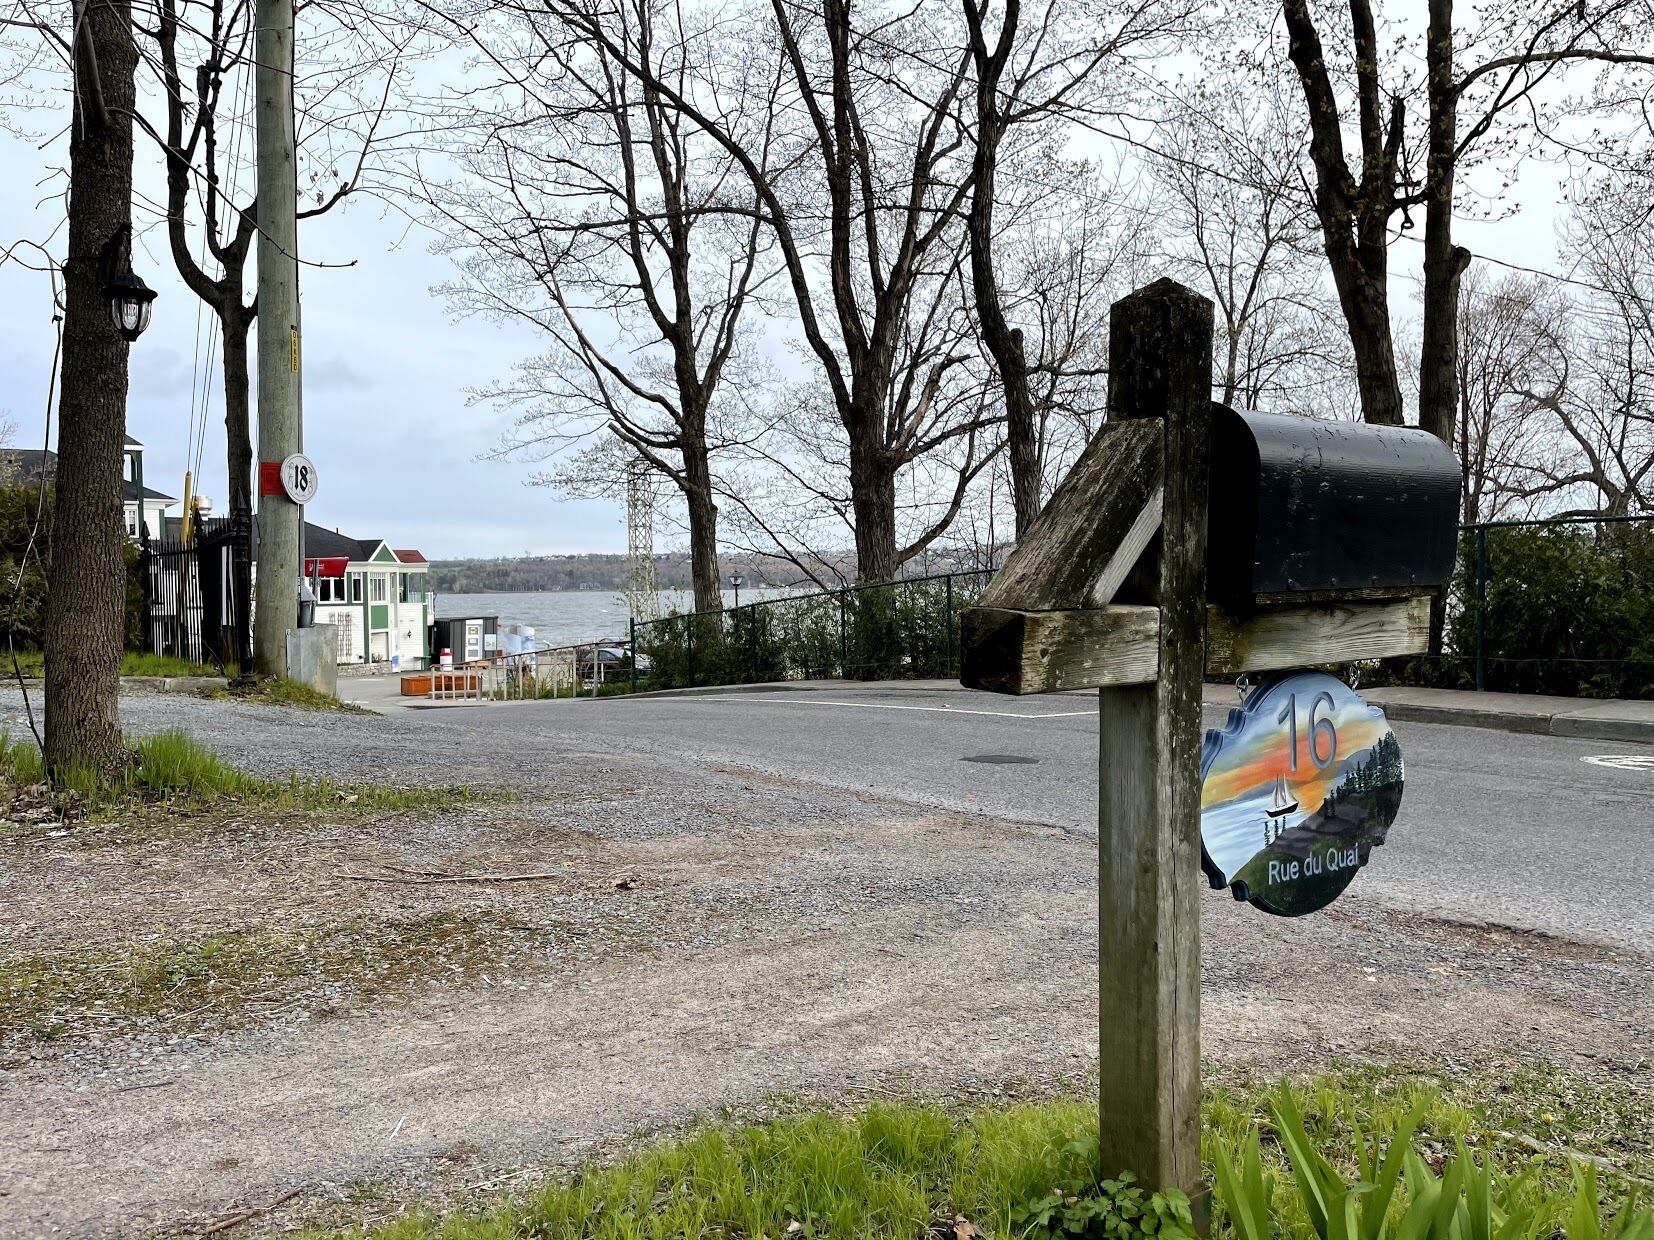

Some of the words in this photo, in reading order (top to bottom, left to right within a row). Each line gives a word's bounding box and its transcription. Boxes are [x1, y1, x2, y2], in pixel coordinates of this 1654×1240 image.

[294, 464, 308, 492] 18
[1278, 691, 1337, 772] 16
[1268, 860, 1300, 885] Rue
[1303, 851, 1322, 876] du
[1326, 842, 1359, 871] Quai
